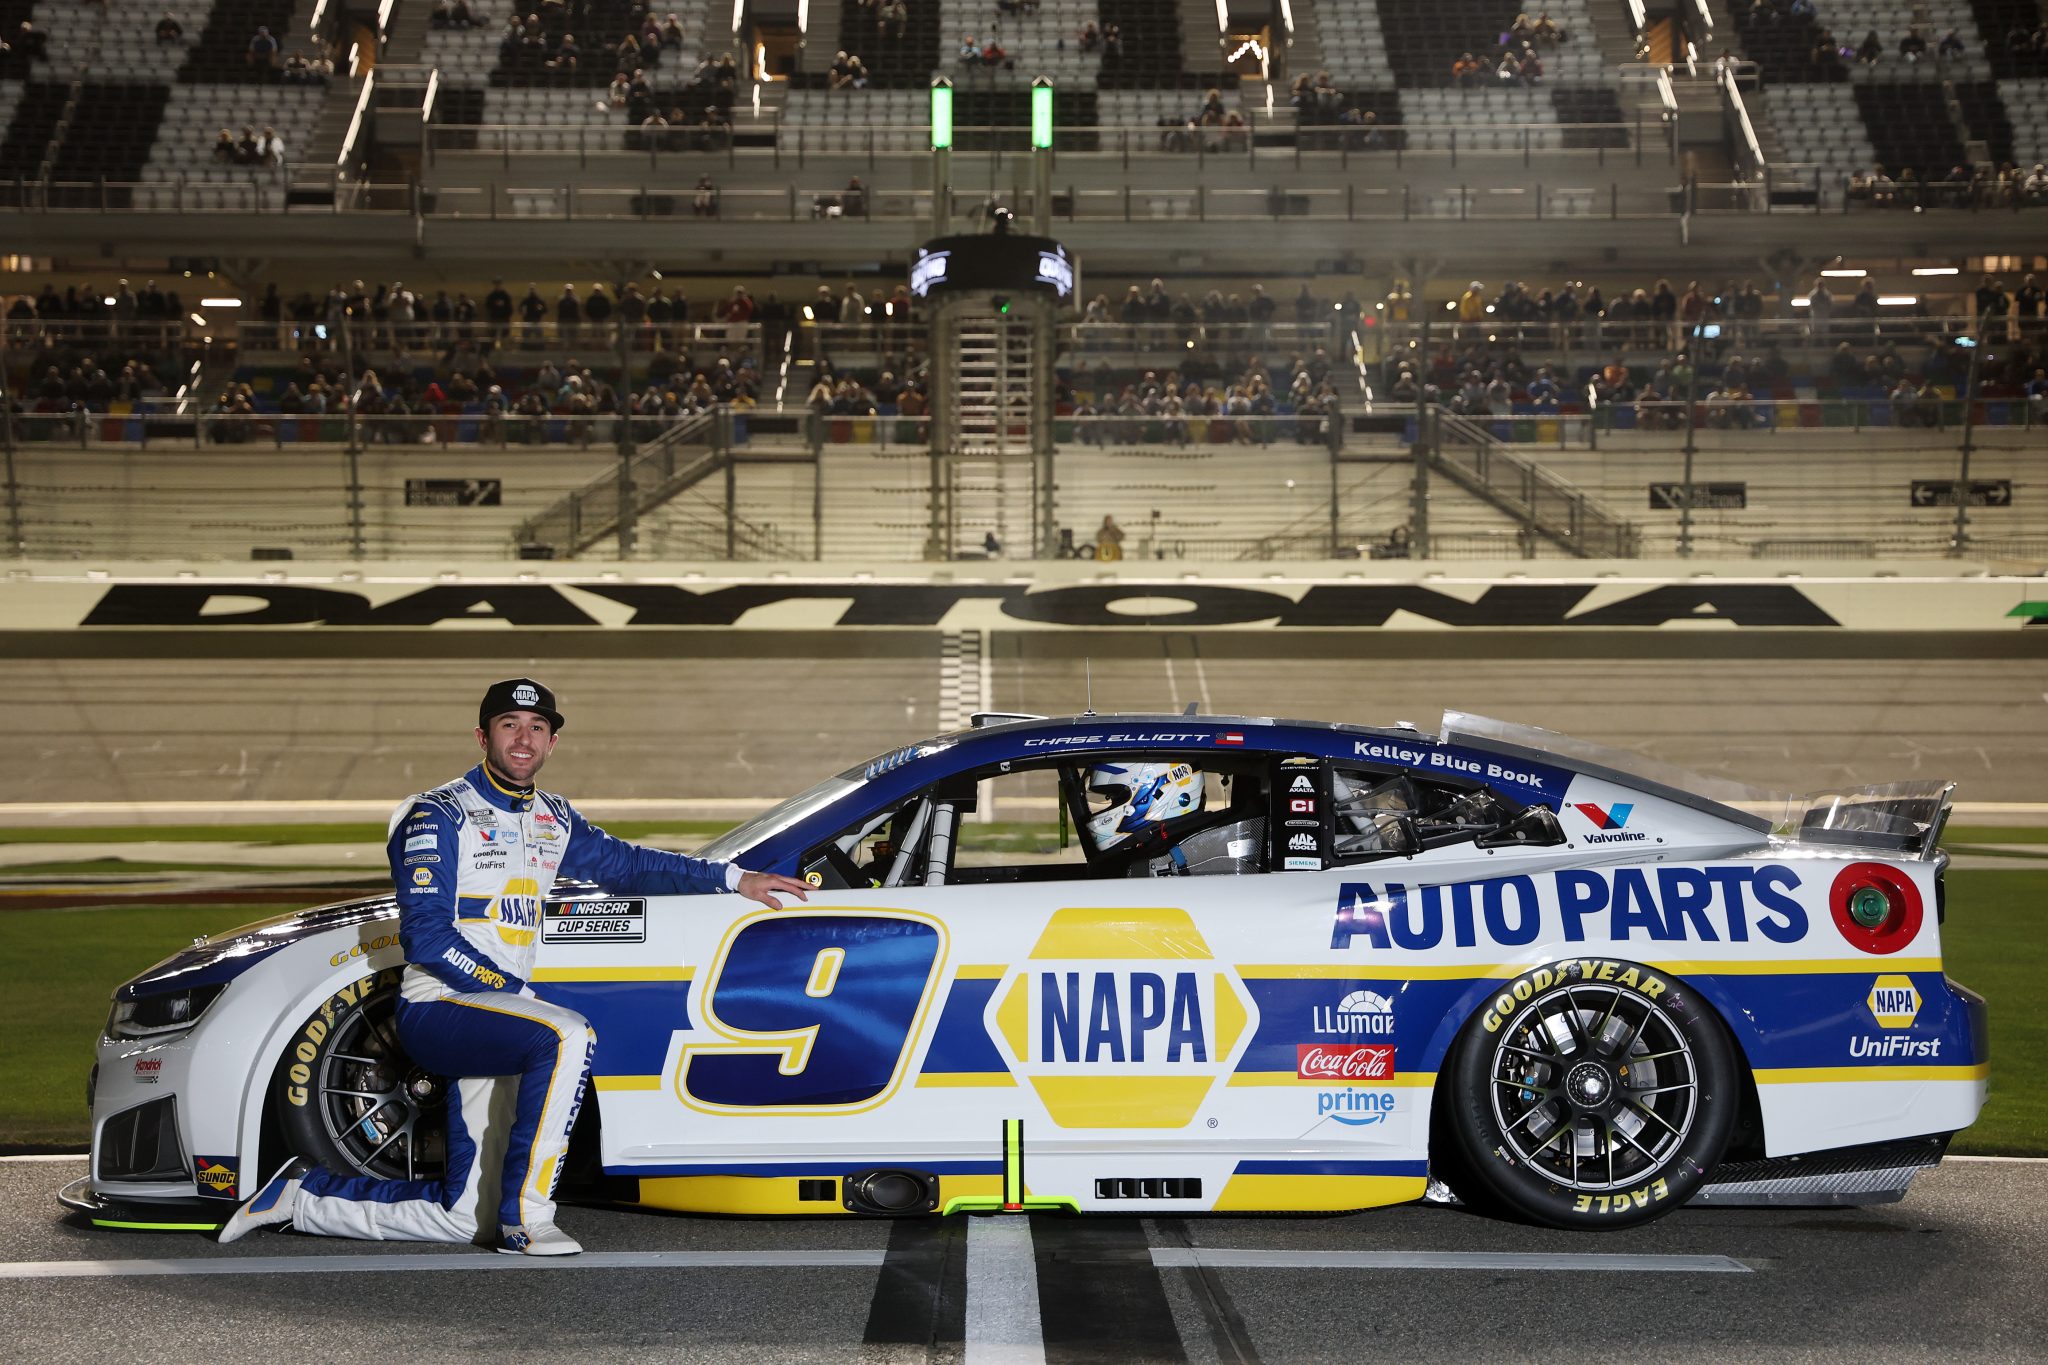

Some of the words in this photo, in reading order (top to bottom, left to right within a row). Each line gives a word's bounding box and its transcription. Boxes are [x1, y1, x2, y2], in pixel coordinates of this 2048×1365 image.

[80, 583, 1844, 626] DAYTONA
[516, 690, 537, 702] NAPA
[1024, 735, 1103, 747] CHASE
[1107, 733, 1211, 742] ELLIOTT
[1354, 741, 1426, 766] Kelley
[1431, 752, 1482, 774] Blue
[1487, 763, 1544, 788] Book
[1291, 800, 1314, 812] CI
[412, 822, 439, 832] Atrium
[502, 829, 519, 838] prime
[408, 839, 434, 848] SIEMENS
[1289, 833, 1317, 845] MAC
[1583, 832, 1646, 844] Valvoline
[473, 849, 508, 858] GOODYEAR
[475, 861, 506, 870] UniFirst
[415, 872, 430, 881] NAPA
[424, 886, 439, 894] CARE
[576, 902, 630, 915] NASCAR
[1330, 873, 1541, 950] AUTO
[1554, 865, 1809, 944] PARTS
[557, 920, 584, 933] CUP
[585, 919, 631, 932] SERIES
[442, 948, 476, 975] AUTO
[473, 965, 507, 990] PARTS
[1482, 959, 1666, 1033] GOODYEAR
[1876, 990, 1914, 1013] NAPA
[675, 907, 950, 1117] 9
[1041, 972, 1208, 1062] NAPA
[1313, 1005, 1394, 1034] LLumar
[288, 971, 399, 1107] GOODYEA
[1849, 1036, 1941, 1058] UniFirst
[1300, 1048, 1392, 1077] Coca-Cola
[1317, 1087, 1395, 1115] prime
[199, 1171, 237, 1184] SUNOC
[1572, 1177, 1669, 1213] EAGLE
